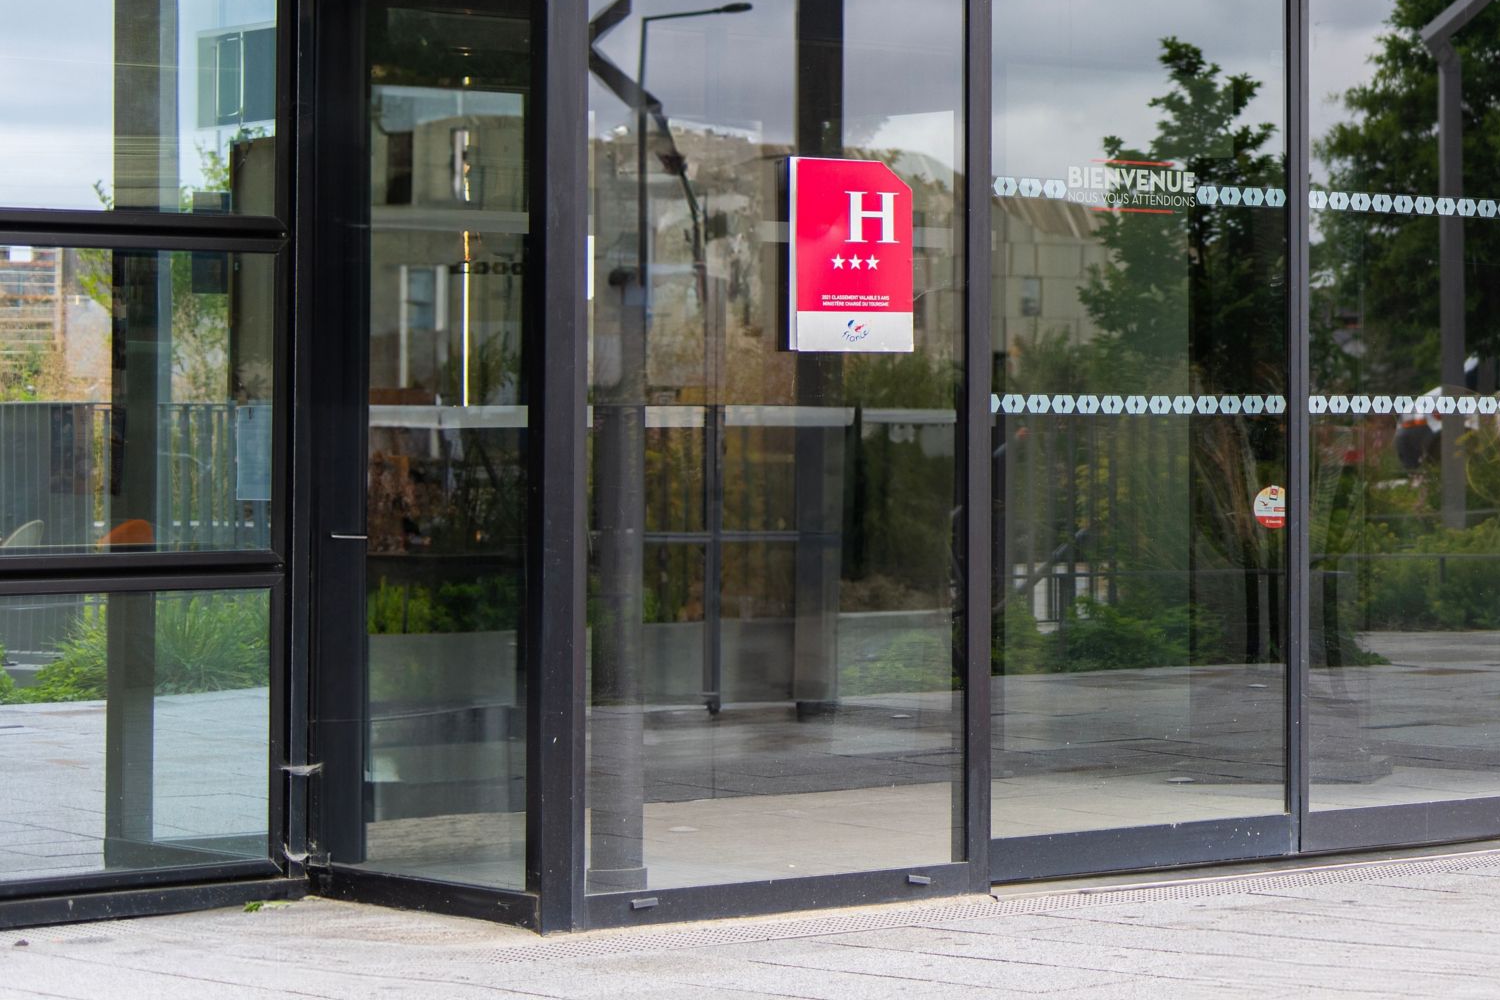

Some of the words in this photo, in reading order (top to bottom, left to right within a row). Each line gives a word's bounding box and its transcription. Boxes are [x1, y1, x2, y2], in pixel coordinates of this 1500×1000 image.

[1068, 166, 1196, 193] BIENVENUE
[1068, 191, 1098, 203] NOUS
[1102, 193, 1129, 204] VOUS
[1131, 195, 1196, 208] ATTENDIONS
[844, 190, 900, 243] H
